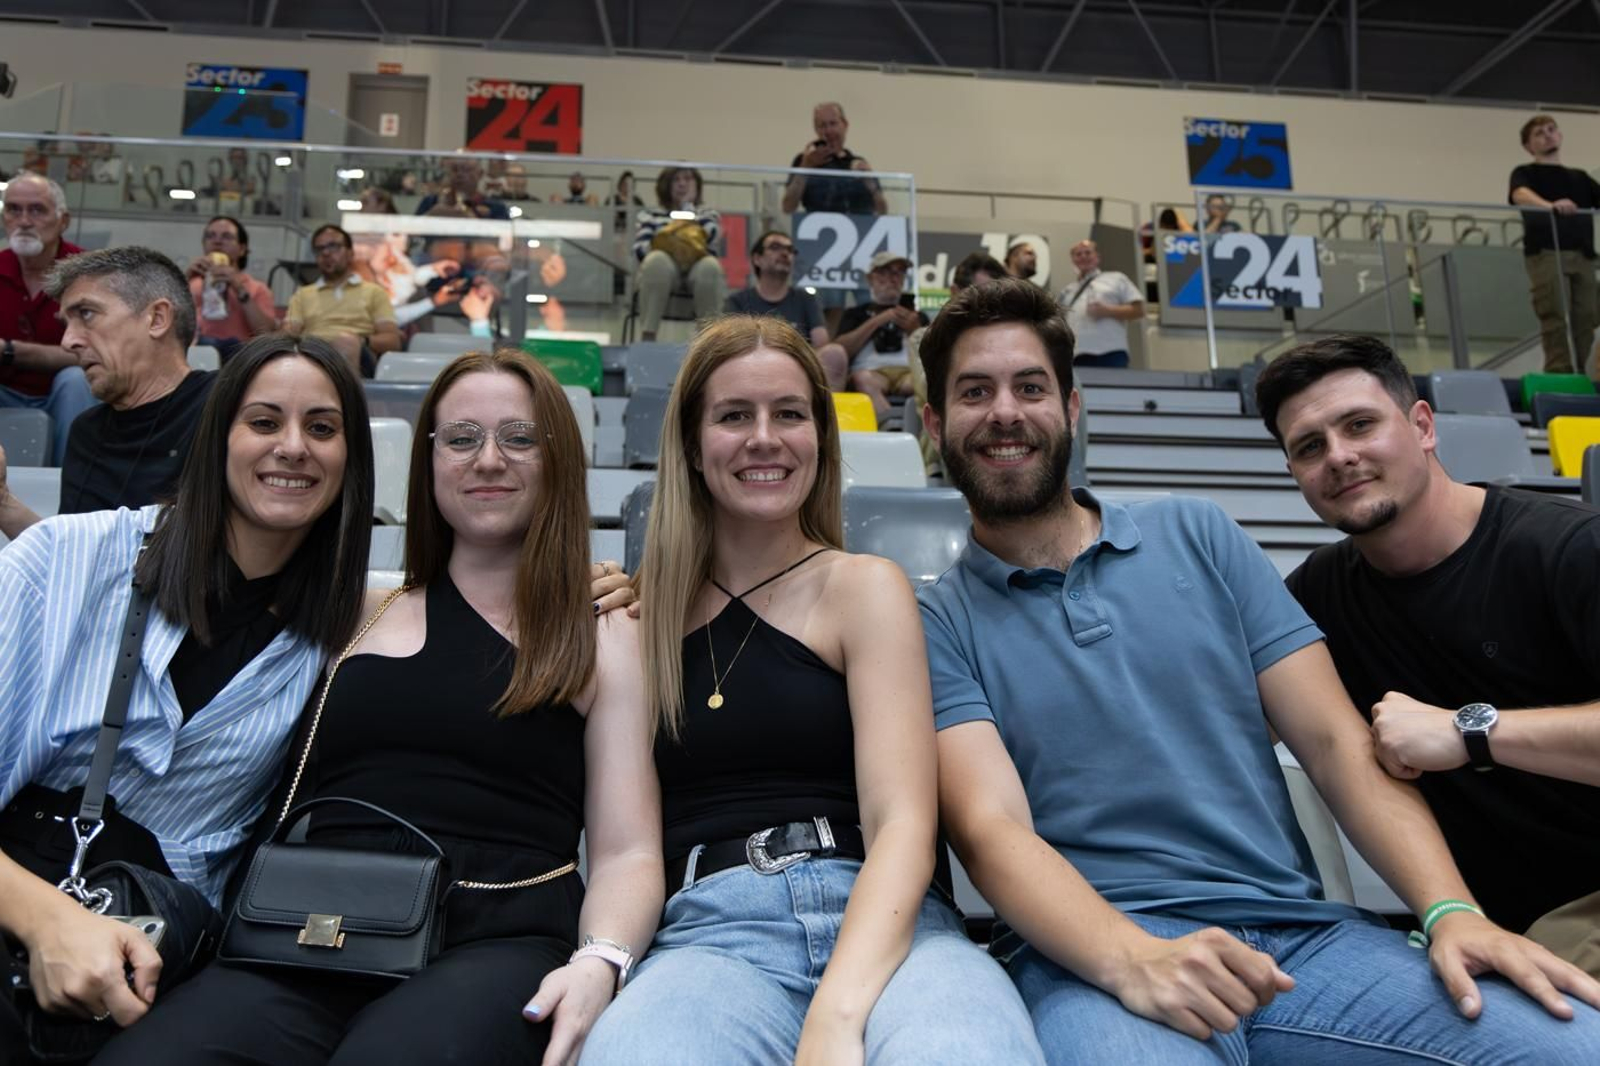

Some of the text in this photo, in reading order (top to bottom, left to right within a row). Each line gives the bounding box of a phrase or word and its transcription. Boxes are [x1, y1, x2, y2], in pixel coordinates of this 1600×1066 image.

[185, 63, 267, 86] Sector
[466, 79, 543, 100] Sector
[466, 83, 580, 154] 24
[1184, 118, 1251, 139] Sector
[1187, 122, 1291, 188] 25
[797, 211, 908, 290] 24
[1164, 235, 1201, 254] Sec
[807, 266, 868, 282] ecto
[1213, 232, 1323, 308] 24
[1211, 278, 1293, 301] Sector
